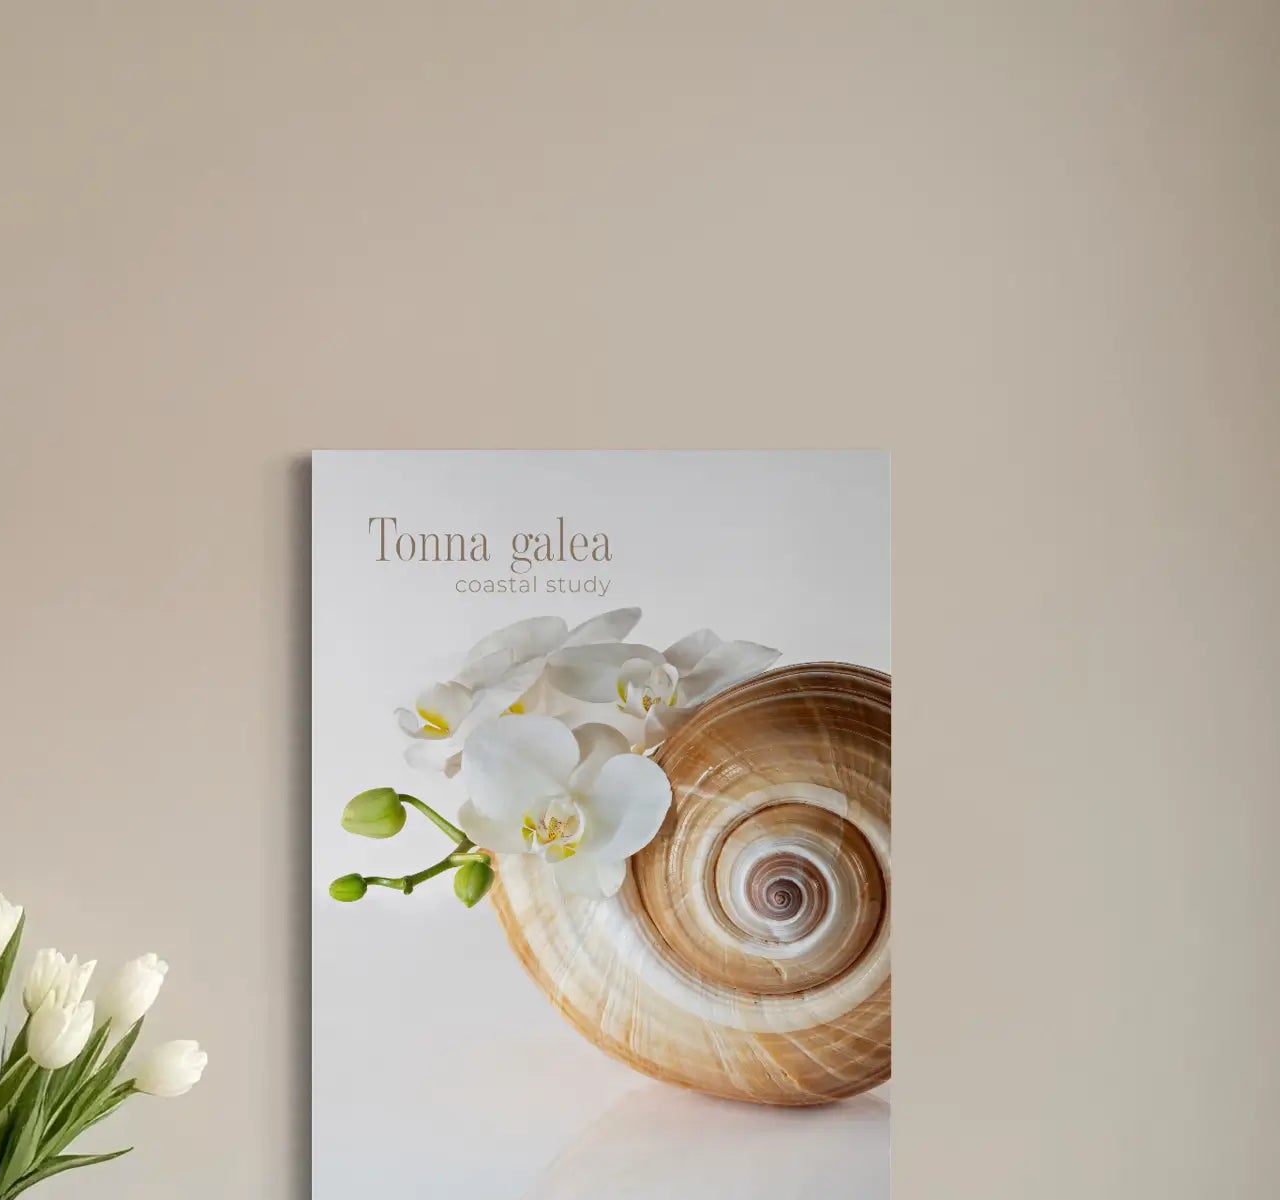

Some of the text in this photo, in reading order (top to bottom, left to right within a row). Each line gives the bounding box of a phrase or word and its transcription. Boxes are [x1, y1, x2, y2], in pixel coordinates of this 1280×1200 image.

[368, 516, 614, 575] Tonna galea
[455, 575, 612, 598] coastal study
